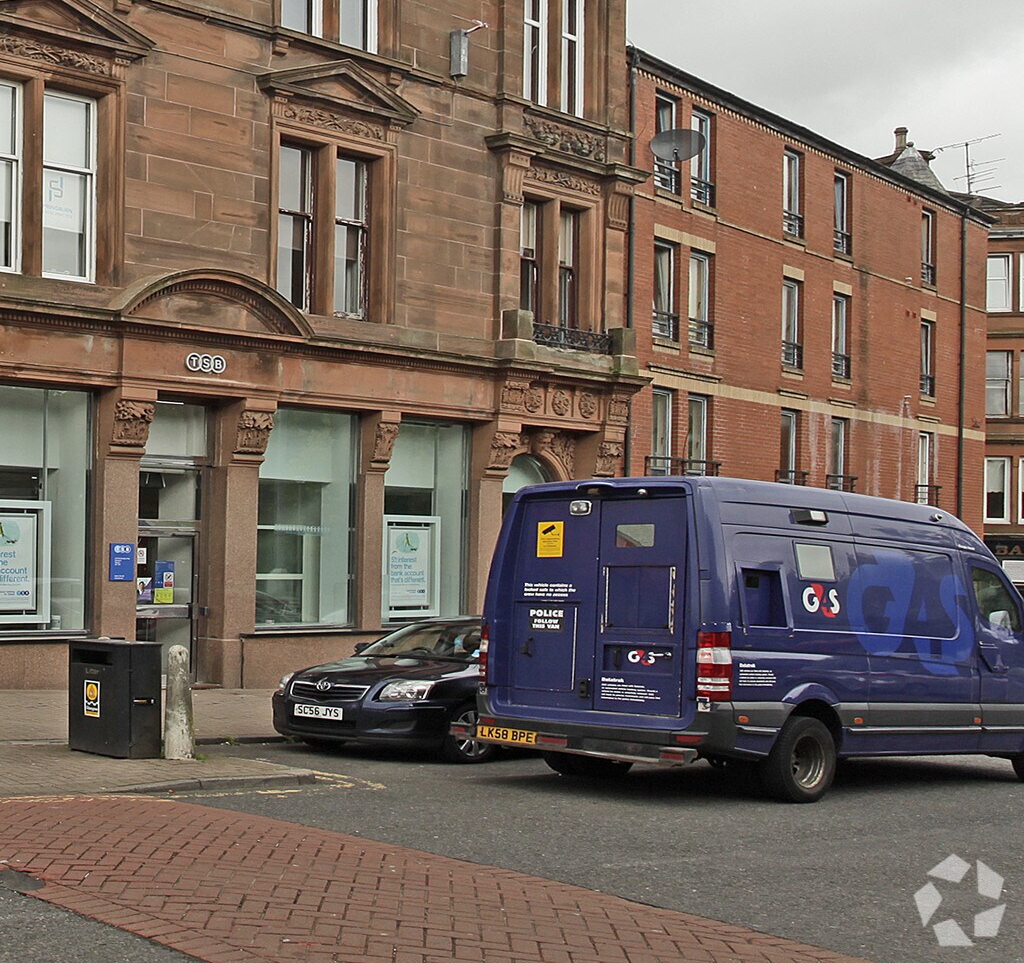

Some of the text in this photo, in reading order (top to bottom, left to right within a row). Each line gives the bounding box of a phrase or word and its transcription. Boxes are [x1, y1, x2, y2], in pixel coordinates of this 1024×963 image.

[189, 354, 224, 372] TSB
[802, 584, 841, 618] G4S
[529, 609, 564, 618] POLICE
[847, 550, 974, 675] G4S
[627, 649, 656, 666] G4S
[297, 705, 339, 718] SC56 JYS
[480, 727, 534, 743] LK58 BPE
